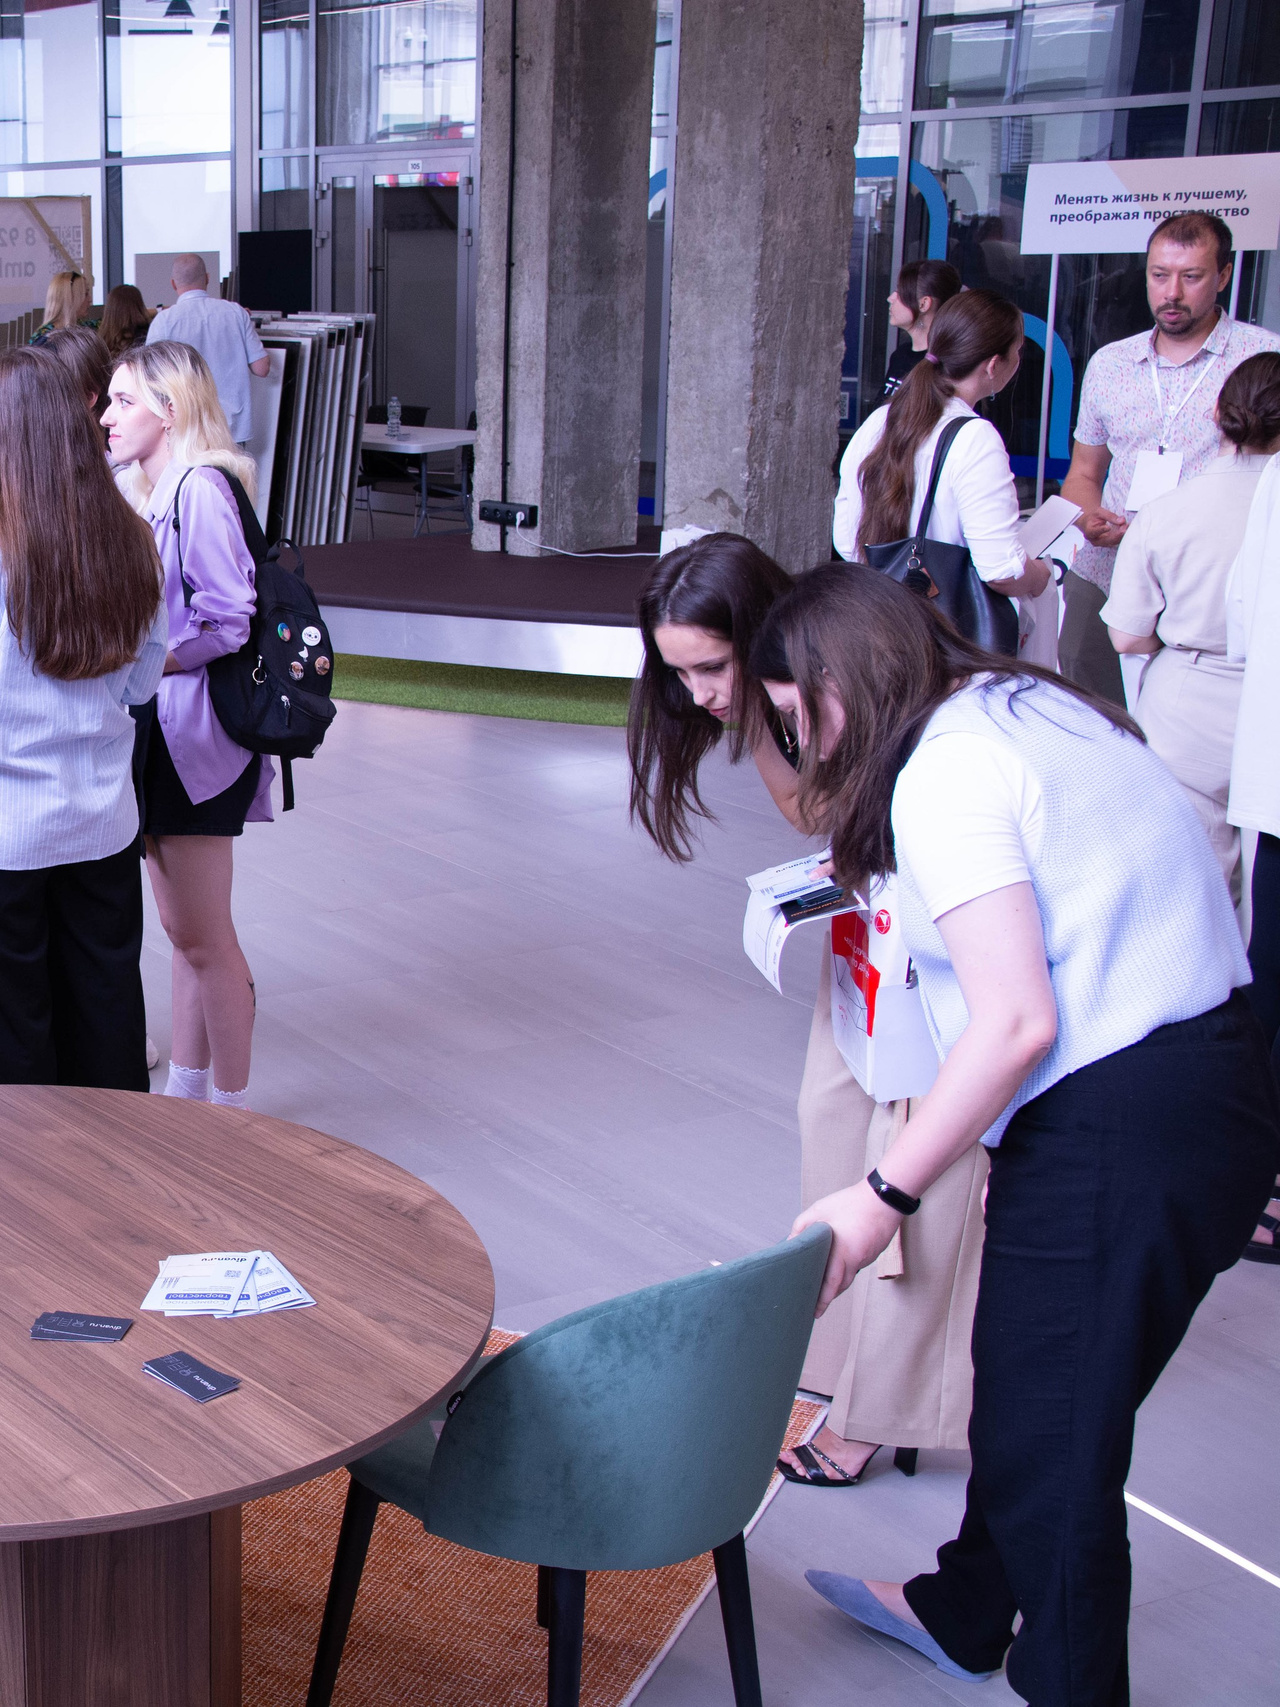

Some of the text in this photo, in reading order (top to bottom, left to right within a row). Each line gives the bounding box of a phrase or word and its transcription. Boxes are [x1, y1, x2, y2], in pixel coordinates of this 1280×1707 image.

[1054, 189, 1247, 205] Менять жизнь к лучшему,
[1050, 207, 1250, 225] преображая проснство
[89, 1322, 122, 1330] divan.ru
